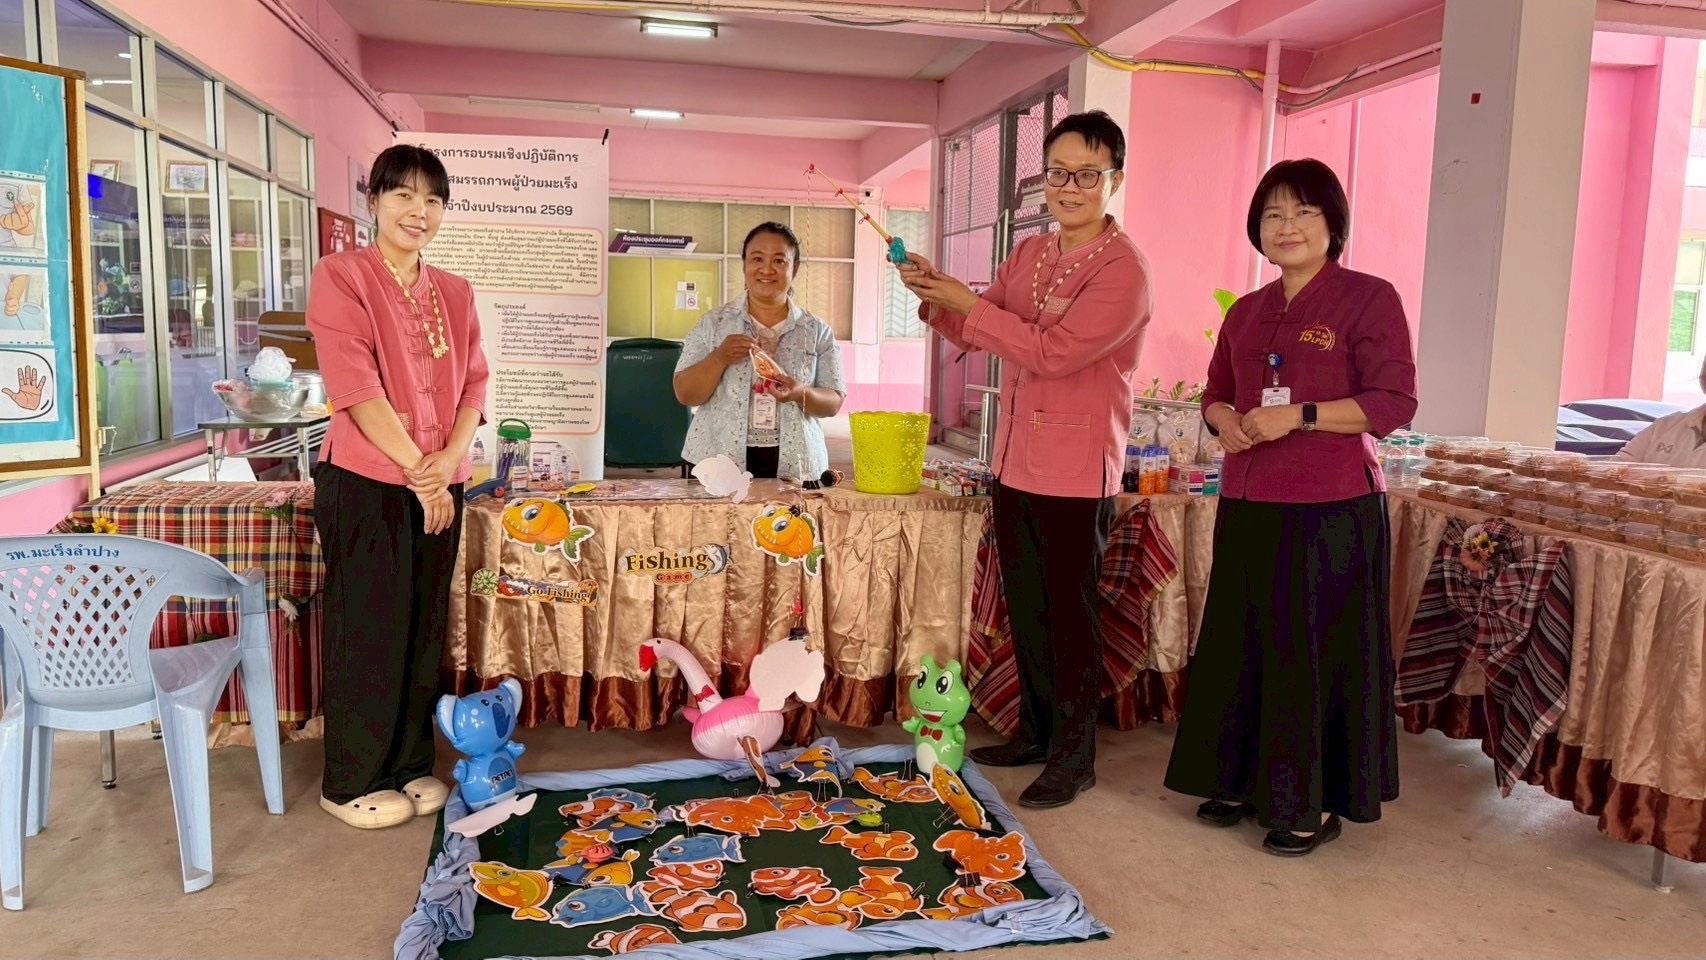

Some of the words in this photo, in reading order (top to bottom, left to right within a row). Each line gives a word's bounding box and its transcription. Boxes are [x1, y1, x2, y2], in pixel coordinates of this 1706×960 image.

[419, 143, 579, 164] รงการอบรมเชิงปฏิบัติการ
[540, 204, 573, 216] 2569
[1298, 330, 1315, 341] 15
[6, 542, 119, 561] รพ.มะเร็งลำปาง
[625, 551, 709, 571] Fishing
[656, 572, 691, 581] Game
[527, 586, 543, 595] Go
